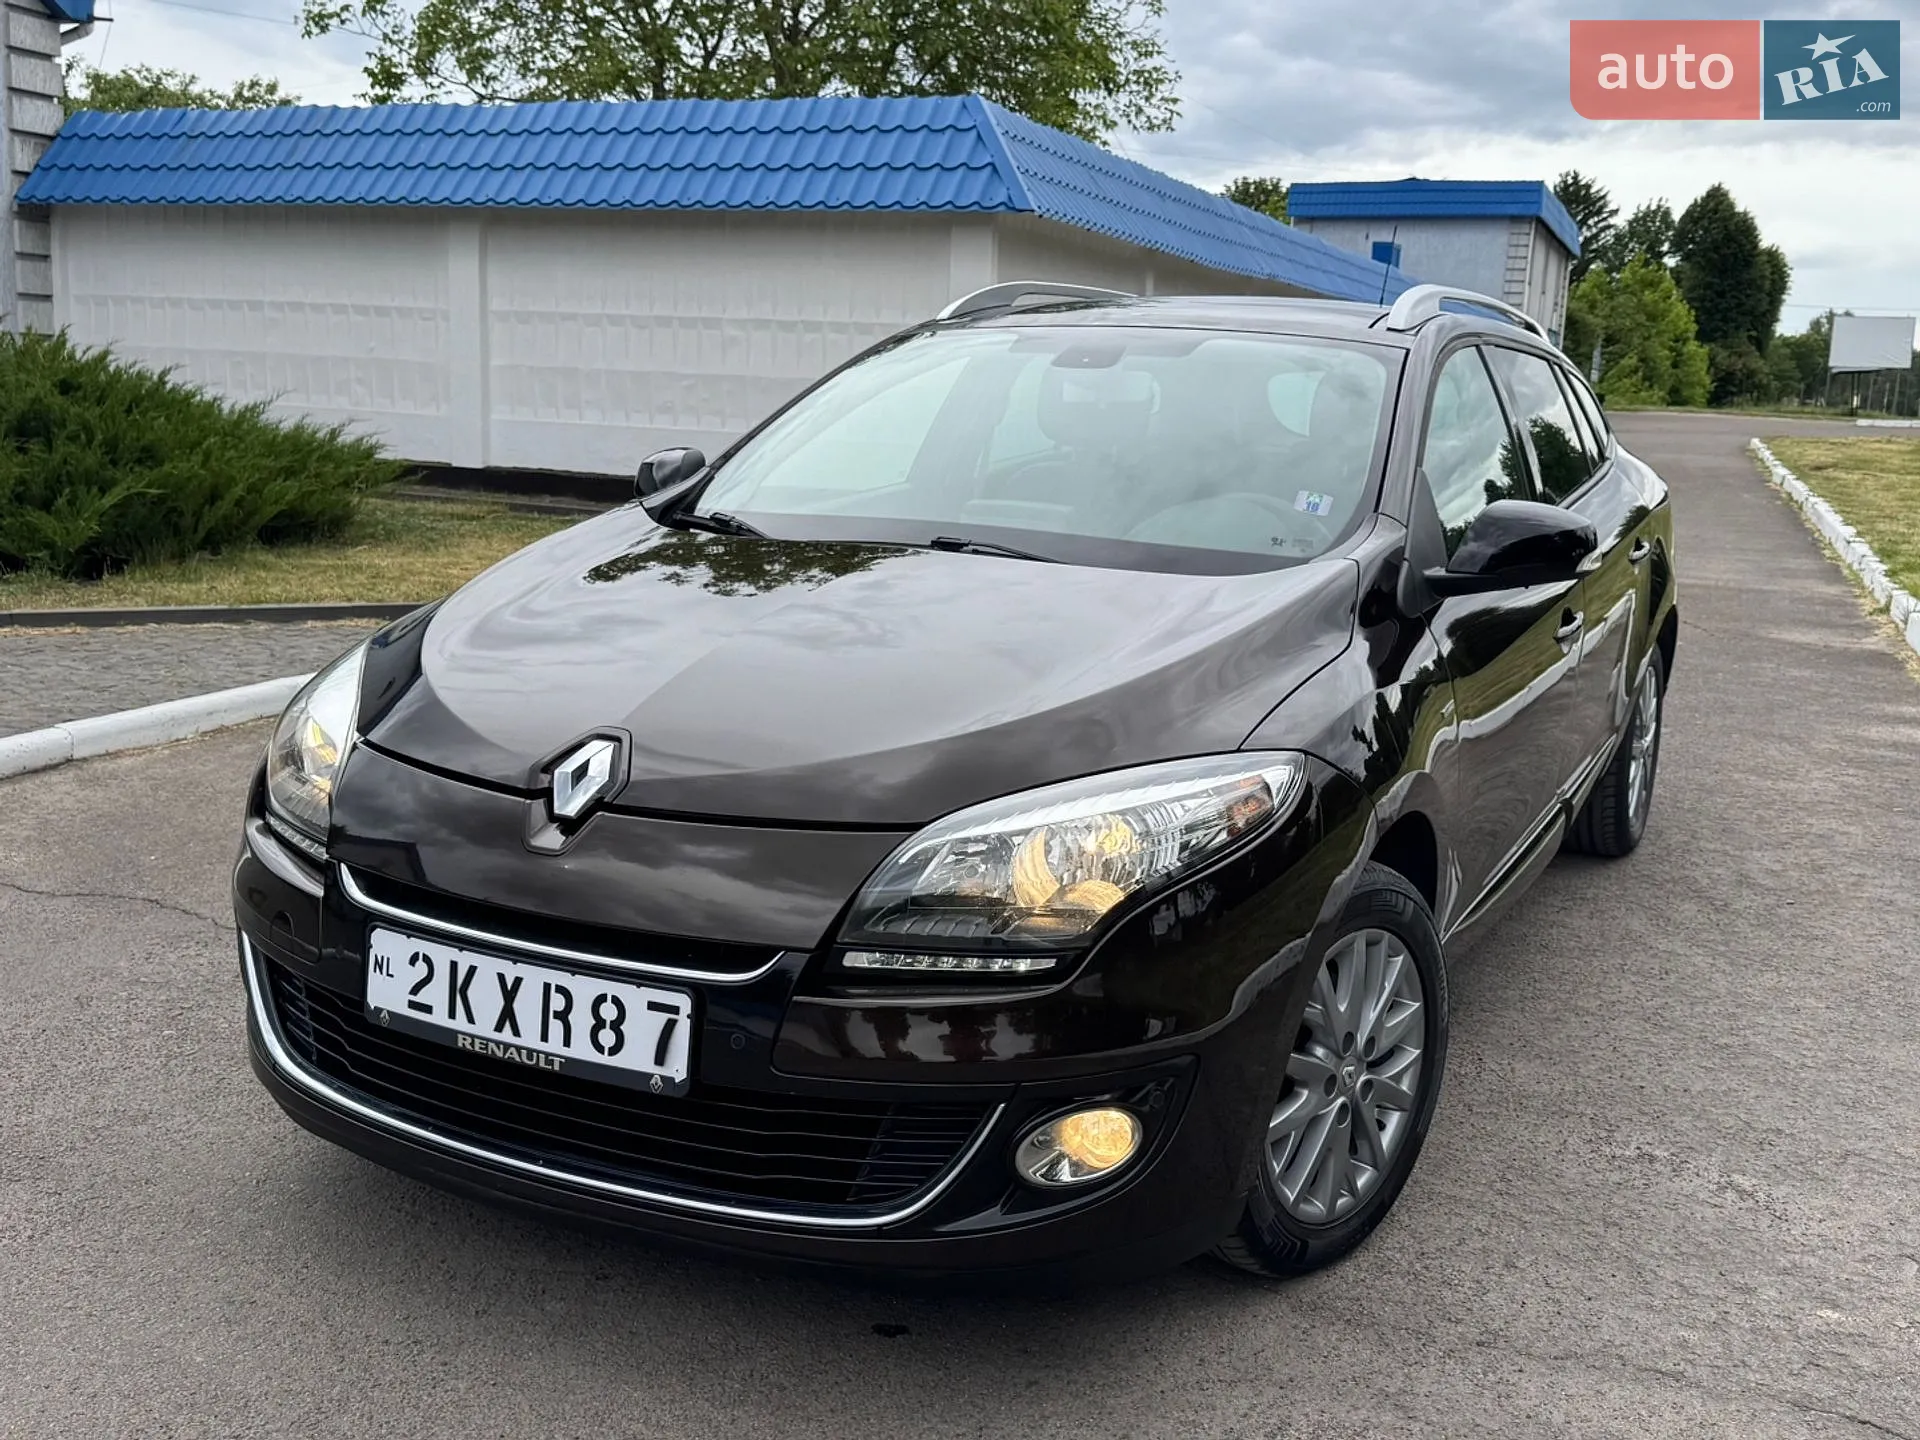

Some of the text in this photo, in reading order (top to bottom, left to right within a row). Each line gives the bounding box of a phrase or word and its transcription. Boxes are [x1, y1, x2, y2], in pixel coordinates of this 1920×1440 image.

[373, 953, 394, 978] NL
[407, 950, 681, 1067] 2KXR87
[457, 1033, 566, 1071] RENAULT
